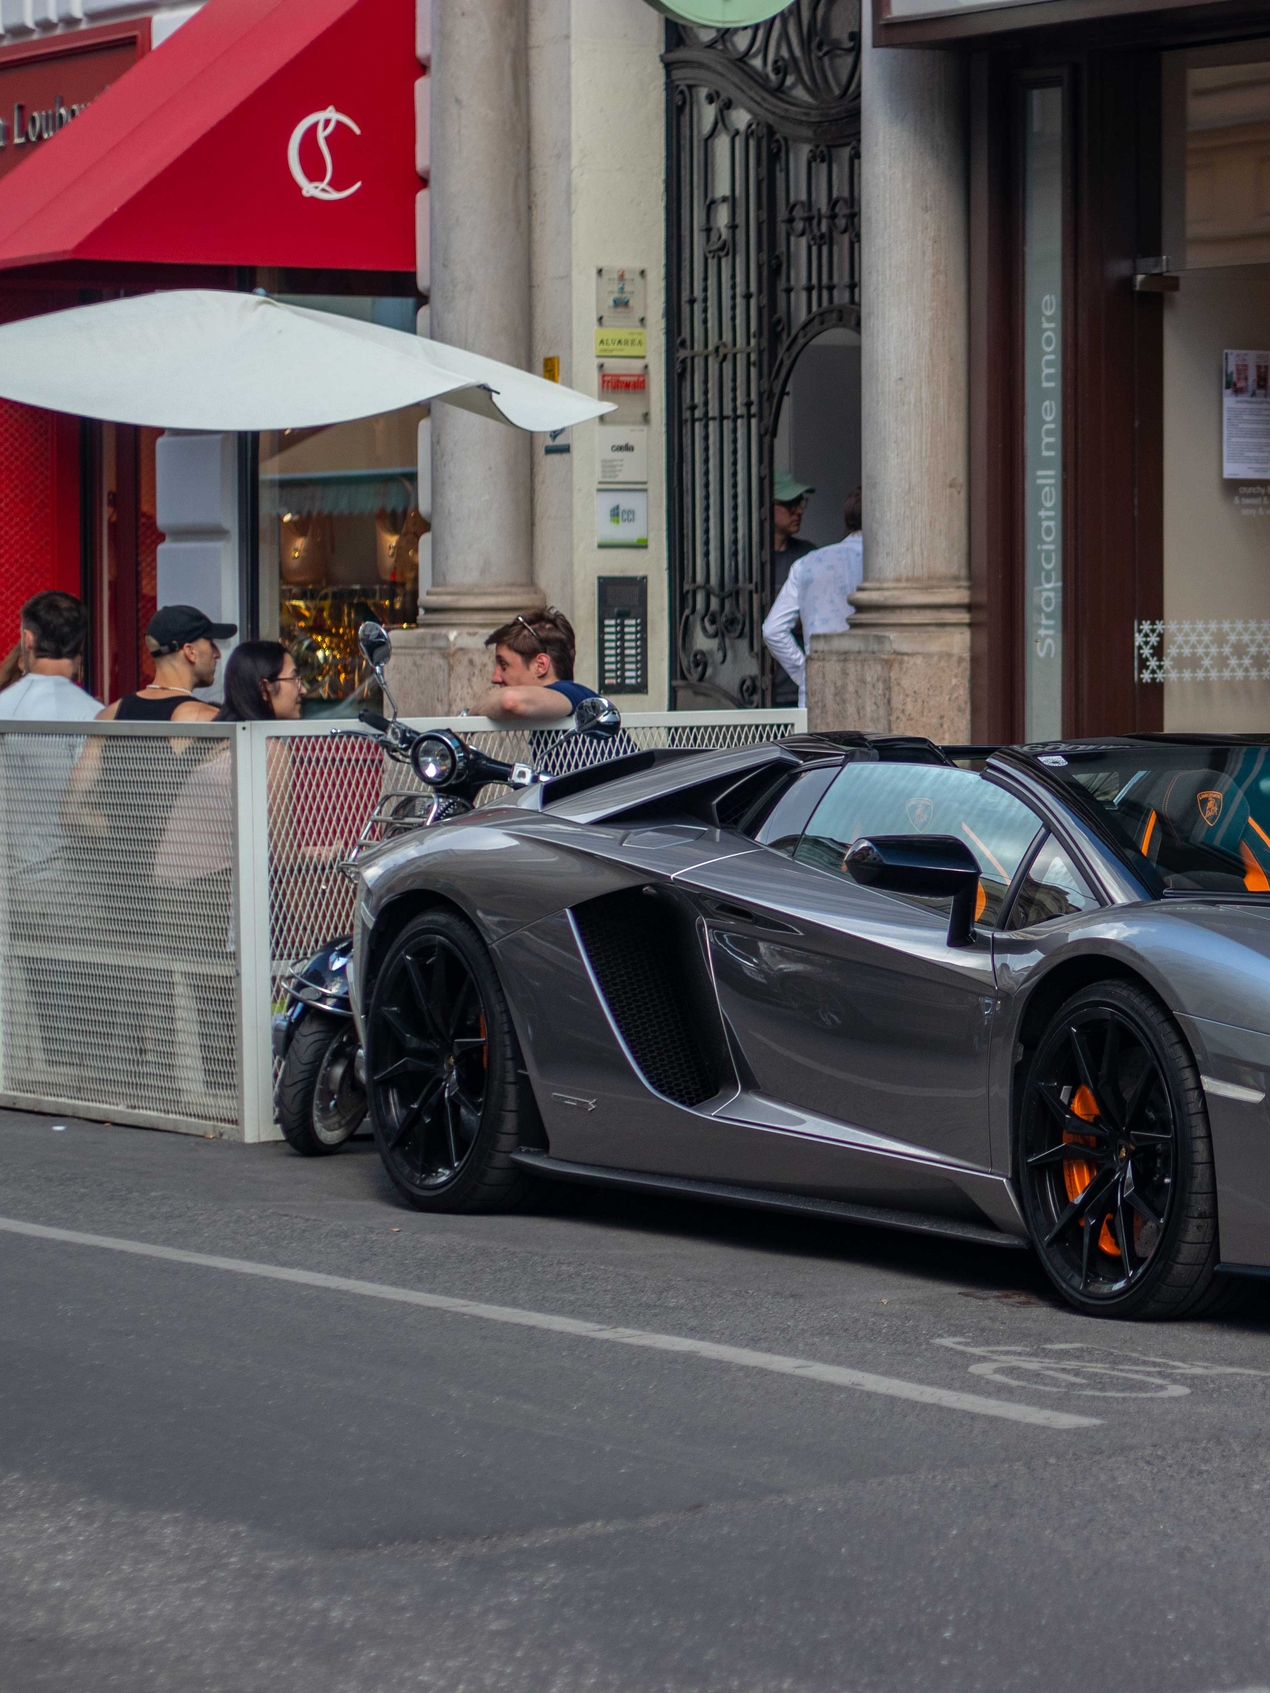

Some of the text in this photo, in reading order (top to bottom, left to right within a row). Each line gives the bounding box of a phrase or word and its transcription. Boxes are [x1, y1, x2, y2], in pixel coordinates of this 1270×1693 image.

[1036, 294, 1056, 658] Stracciatell me more
